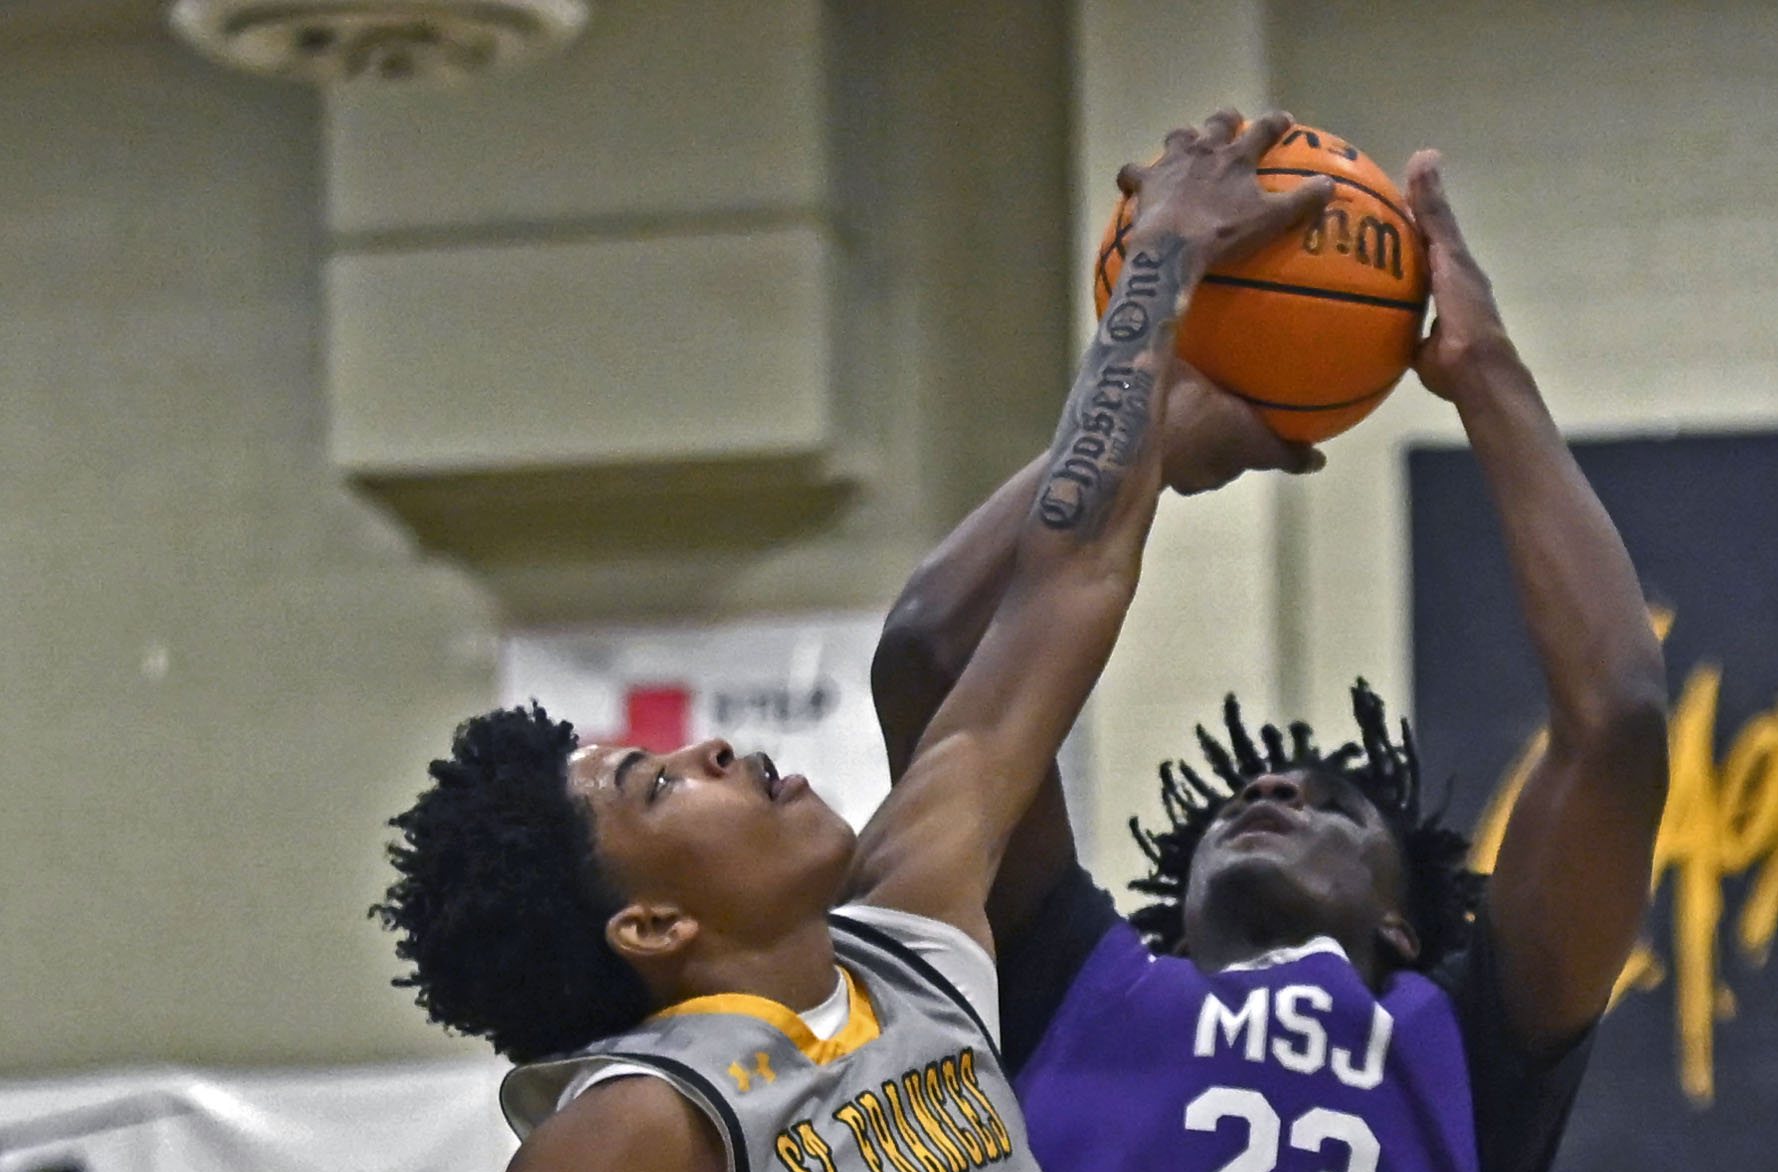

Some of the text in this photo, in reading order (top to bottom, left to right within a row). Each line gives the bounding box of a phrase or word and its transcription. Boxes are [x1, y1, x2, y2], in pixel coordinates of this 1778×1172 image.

[1040, 366, 1134, 530] Chosen
[1106, 249, 1164, 343] One
[1194, 984, 1395, 1090] MSJ
